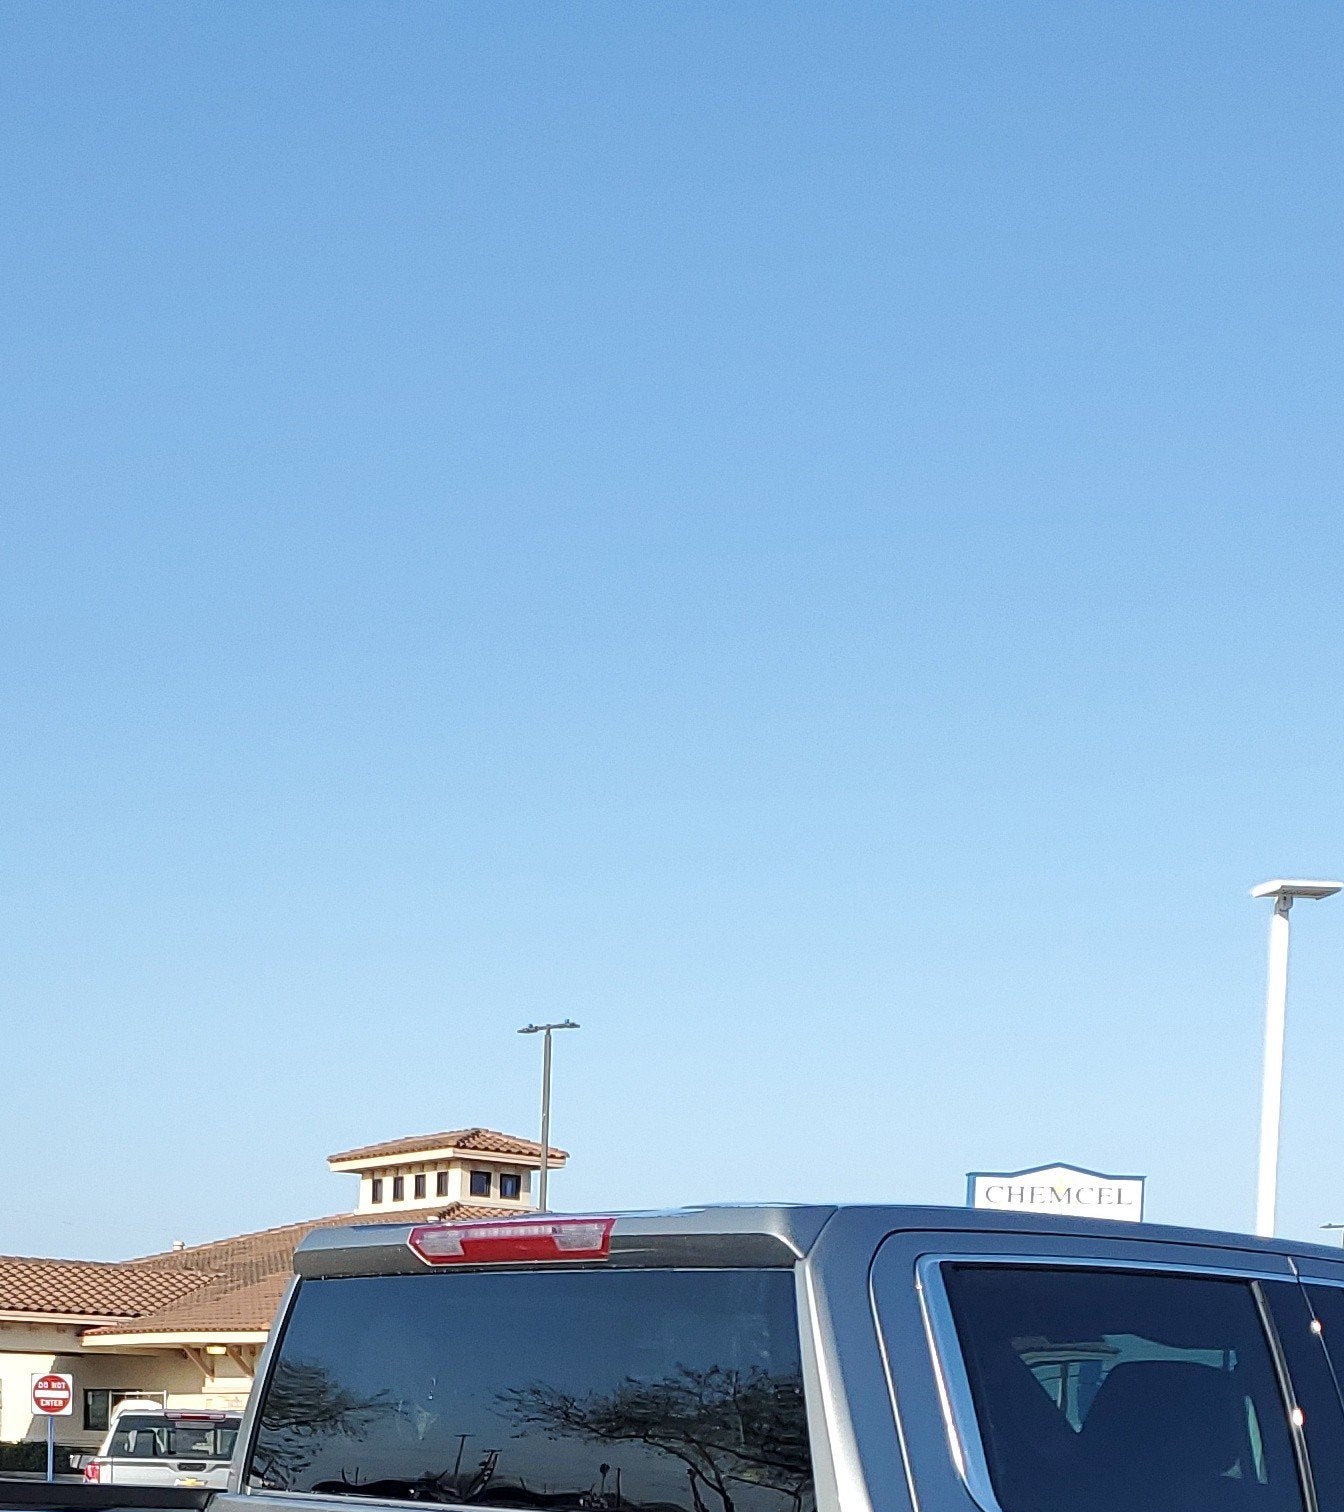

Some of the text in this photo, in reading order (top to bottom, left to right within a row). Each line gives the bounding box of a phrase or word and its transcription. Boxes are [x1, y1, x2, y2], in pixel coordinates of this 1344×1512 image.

[985, 1185, 1133, 1206] CHEMCEL
[38, 1381, 66, 1389] DO NOT
[40, 1399, 64, 1407] ENTER
